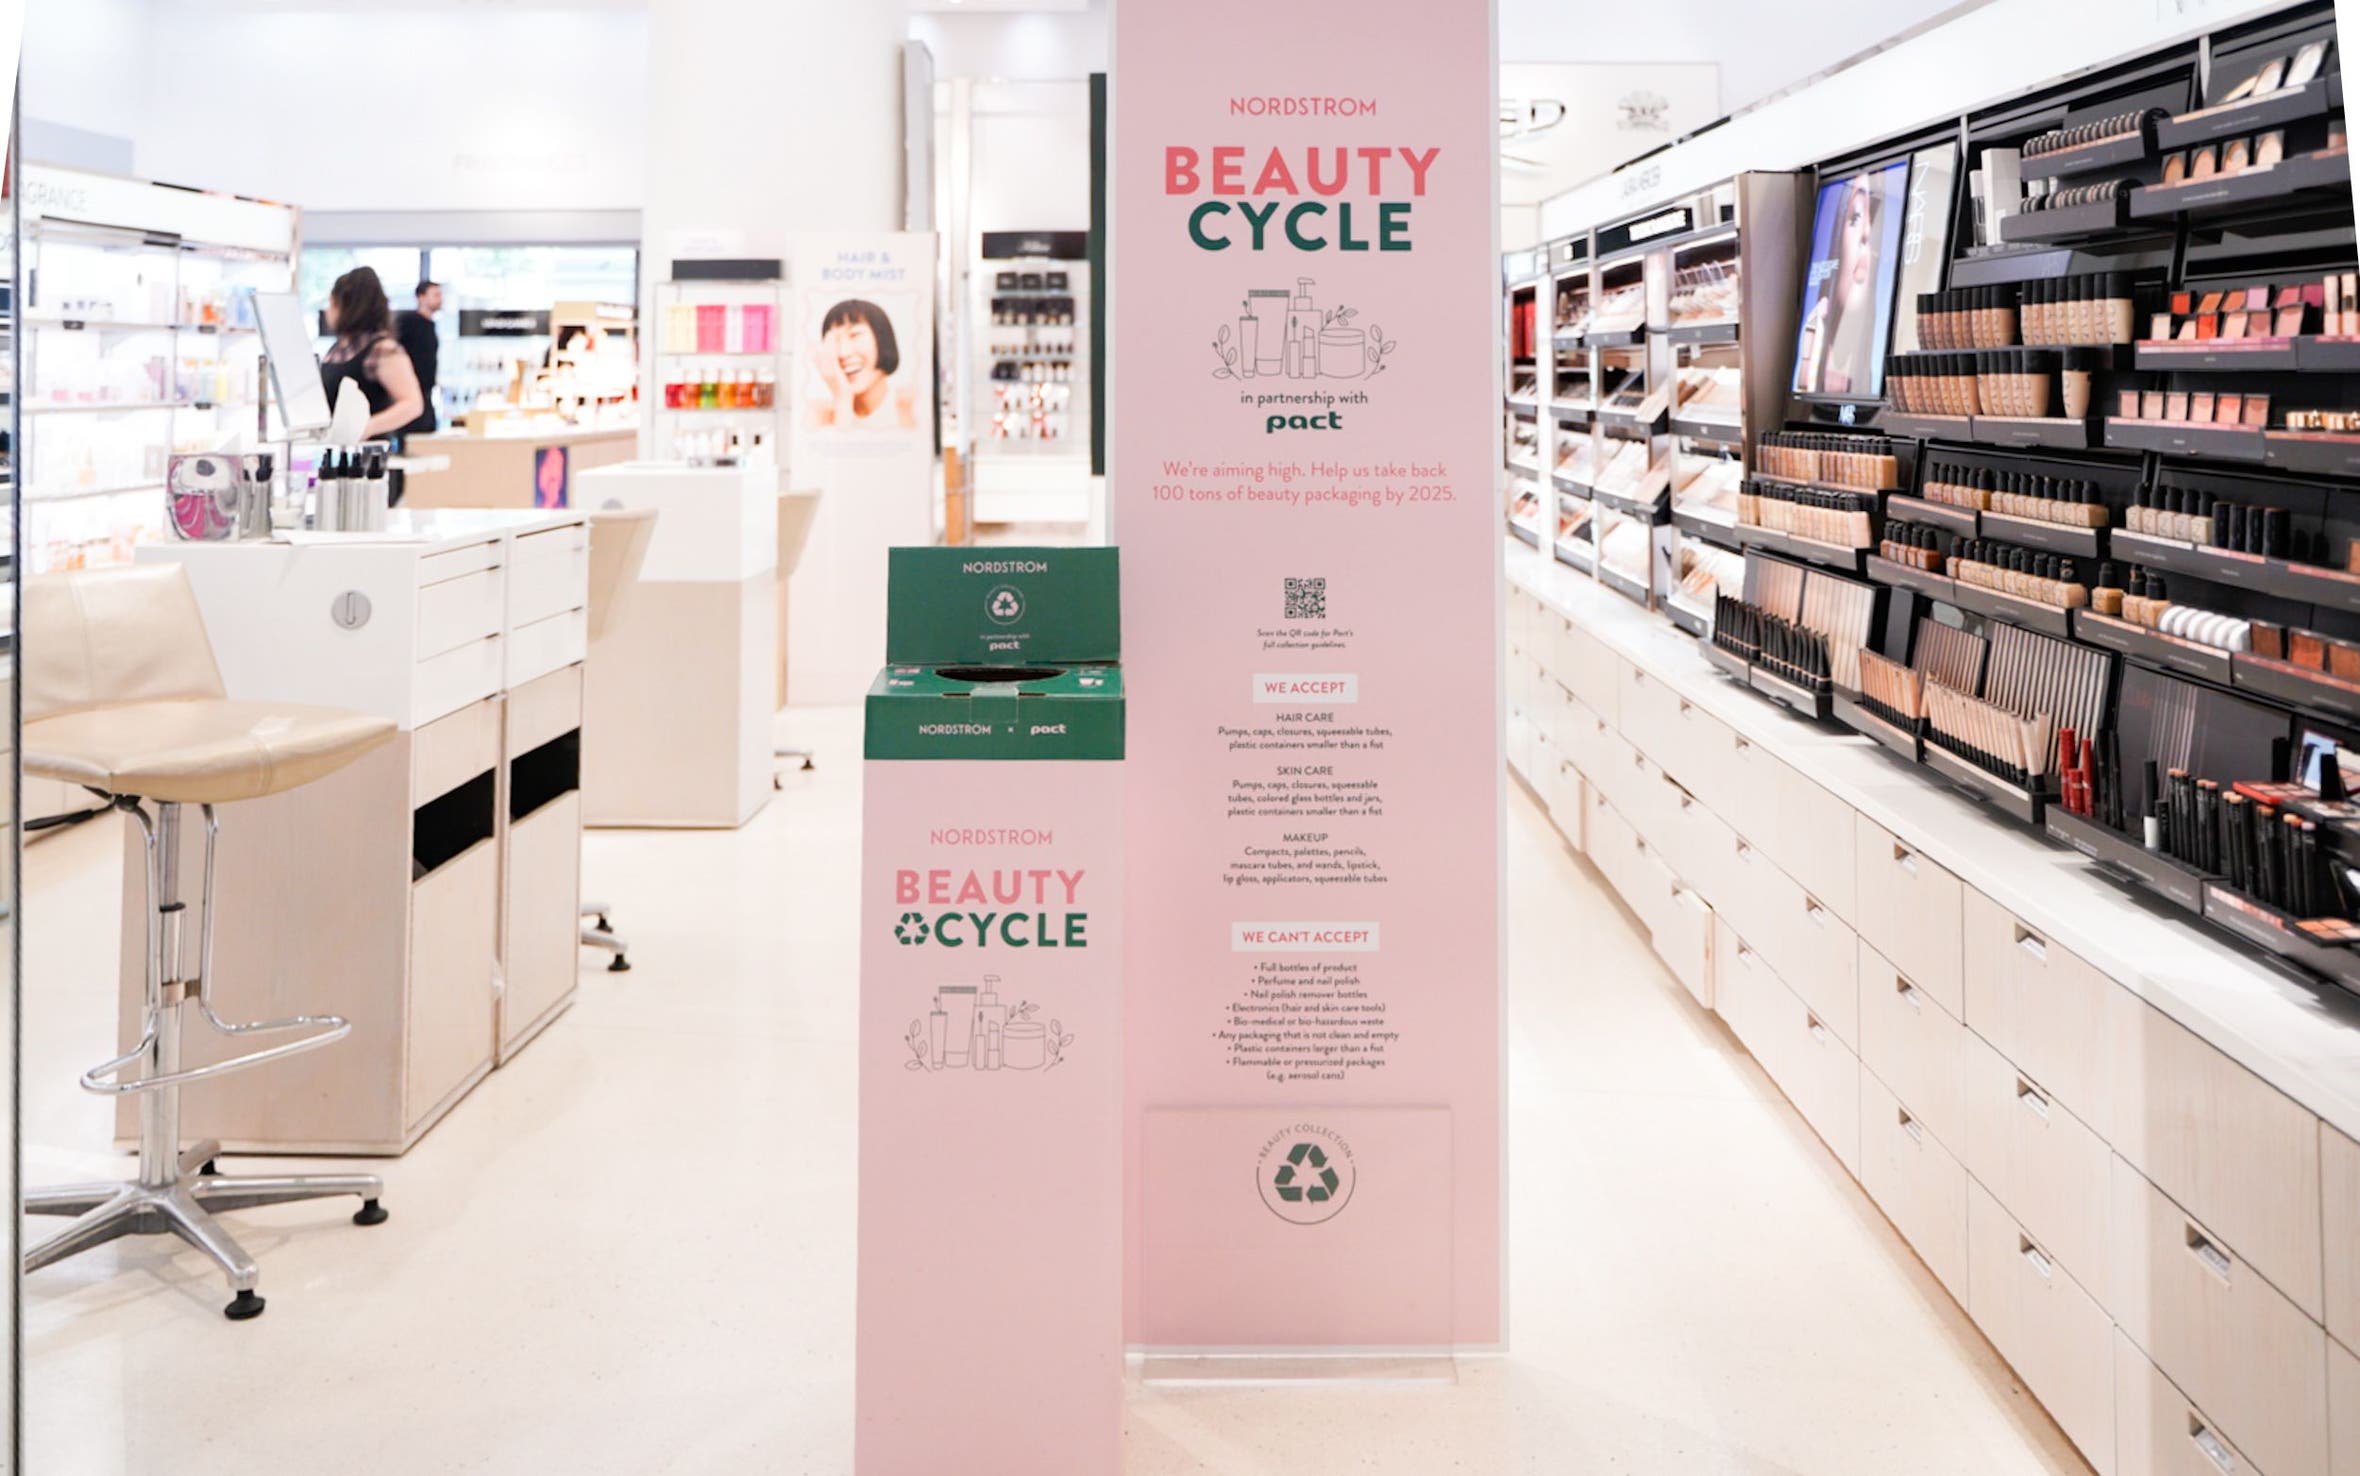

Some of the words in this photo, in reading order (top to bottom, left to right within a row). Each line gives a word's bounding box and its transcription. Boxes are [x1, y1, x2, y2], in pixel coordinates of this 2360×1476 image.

[1230, 97, 1376, 116] NORDSTROM
[1165, 146, 1440, 196] BEAUTY
[1188, 201, 1412, 251] CYCLE
[1241, 391, 1253, 403] in
[1258, 391, 1335, 408] partnership
[1339, 391, 1368, 404] with
[1267, 411, 1342, 434] pact
[1163, 461, 1208, 477] We're
[1213, 462, 1264, 483] aiming
[1268, 462, 1305, 483] high.
[1311, 462, 1348, 482] Help
[1353, 467, 1369, 477] us
[1374, 463, 1406, 477] take
[1411, 463, 1446, 477] back
[1153, 485, 1184, 500] 100
[1189, 489, 1222, 501] tons
[1227, 485, 1244, 501] of
[1247, 486, 1300, 506] beauty
[1305, 486, 1381, 507] packaging
[1386, 487, 1404, 506] by
[1409, 486, 1456, 501] 2025.
[963, 561, 1047, 573] NORDSTROM
[1289, 629, 1302, 638] QR
[989, 641, 1021, 651] pact
[1263, 640, 1275, 650] full
[1265, 682, 1286, 693] WE
[1290, 682, 1345, 694] ACCEPT
[1276, 713, 1303, 722] HAIR
[1305, 712, 1333, 722] CARE
[919, 724, 992, 735] NORDSTROM
[1030, 724, 1067, 735] pact
[1229, 741, 1256, 751] plastic
[1307, 740, 1338, 748] smaller
[1340, 740, 1360, 749] than
[1370, 740, 1383, 749] fist
[1277, 766, 1302, 775] SKIN
[1304, 766, 1333, 776] CARE
[1257, 793, 1289, 802] colored
[1291, 794, 1312, 805] glass
[1314, 794, 1344, 802] bottles
[1228, 807, 1255, 818] plastic
[1306, 807, 1337, 816] smaller
[1339, 807, 1359, 815] than
[1368, 806, 1382, 815] fist
[931, 829, 1052, 845] NORDSTROM
[1283, 833, 1328, 842] MAKEUP
[1223, 874, 1234, 885] lip
[1364, 874, 1388, 882] tubes
[896, 870, 1084, 905] BEAUTY
[934, 912, 1087, 947] CYCLE
[1243, 931, 1264, 943] WE
[1268, 931, 1310, 943] CAN'T
[1313, 931, 1368, 943] ACCEPT
[1260, 962, 1276, 972] Full
[1279, 964, 1309, 972] bottles
[1323, 964, 1357, 973] product
[1258, 976, 1296, 985] Perfume
[1334, 976, 1360, 987] polish
[1251, 990, 1269, 999] Nail
[1271, 990, 1296, 1001] polish
[1337, 990, 1367, 998] bottles
[1232, 1003, 1279, 1012] Electronics
[1282, 1003, 1302, 1012] (hair
[1304, 1003, 1320, 1012] and
[1322, 1003, 1339, 1012] skin
[1361, 1004, 1385, 1012] tools)
[1234, 1016, 1285, 1026] Bio-medical
[1218, 1030, 1236, 1041] Any
[1238, 1031, 1281, 1041] packaging
[1283, 1030, 1301, 1039] that
[1329, 1031, 1351, 1039] clean
[1371, 1032, 1399, 1041] empty
[1234, 1043, 1262, 1052] Plastic
[1313, 1044, 1338, 1055] larger
[1340, 1044, 1360, 1052] than
[1370, 1043, 1383, 1052] fist
[1233, 1057, 1281, 1066] Flammable
[1346, 1058, 1385, 1068] packages
[1288, 1071, 1319, 1080] aerosol
[1321, 1071, 1344, 1080] cans)
[1258, 1126, 1292, 1159] BEAUTY
[1294, 1123, 1354, 1159] COLLECTION
